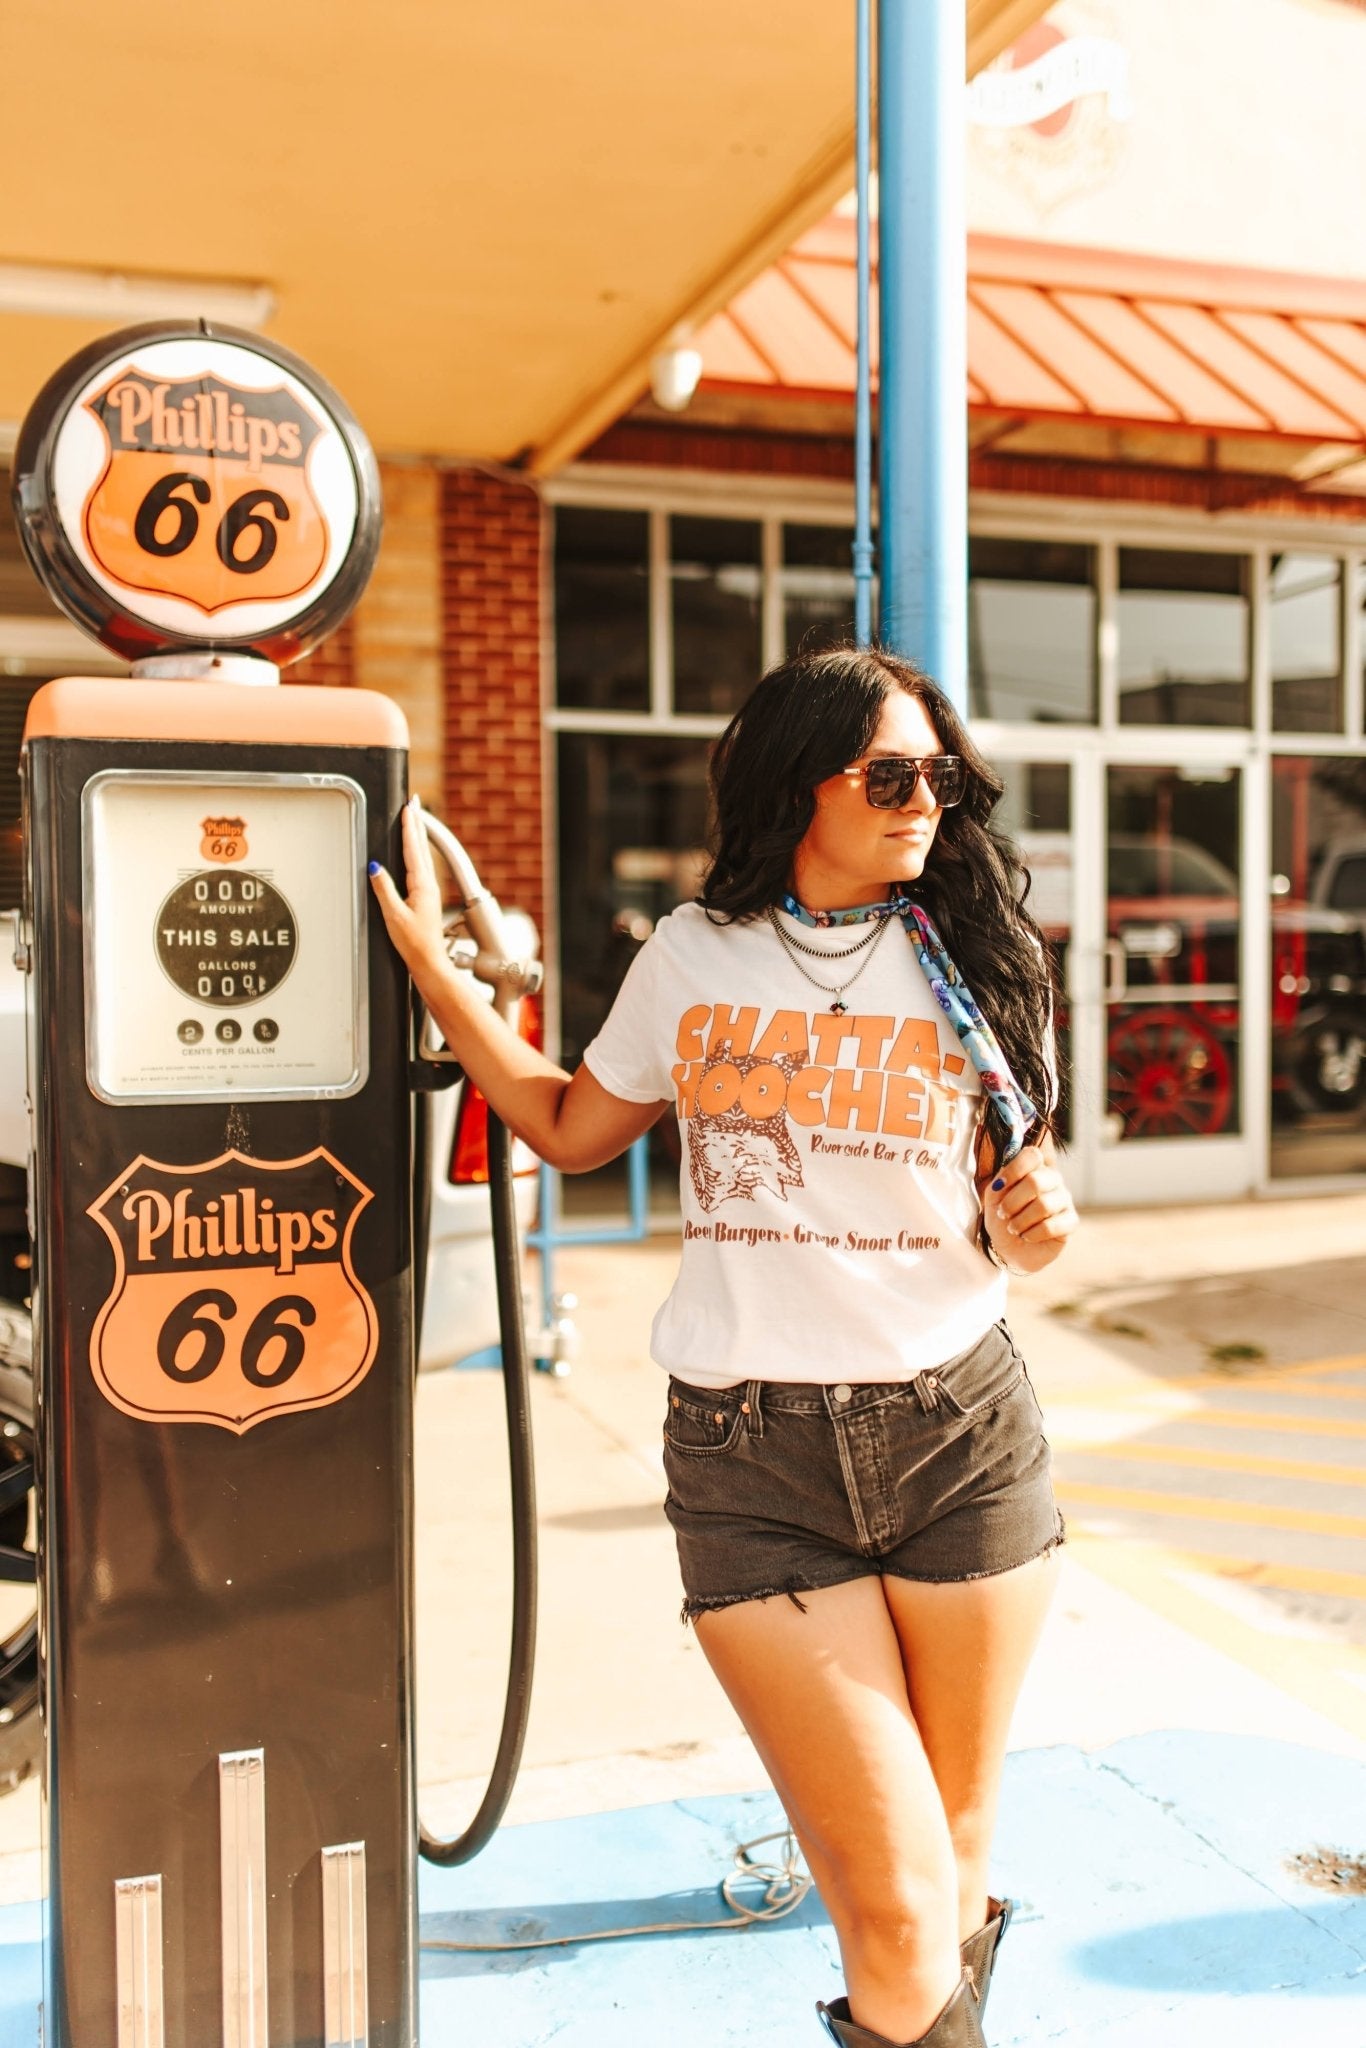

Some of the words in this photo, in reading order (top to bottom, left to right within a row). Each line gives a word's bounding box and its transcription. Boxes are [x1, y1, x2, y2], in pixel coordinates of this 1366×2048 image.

[107, 380, 303, 472] Phillips
[134, 472, 290, 575] 66
[204, 822, 242, 837] Phillips
[211, 839, 238, 857] 66
[199, 904, 254, 914] AMOUNT
[163, 929, 217, 946] THIS
[230, 929, 290, 946] SALE
[198, 961, 257, 971] GALLONS
[222, 1025, 234, 1039] 6
[182, 1047, 213, 1057] CENTS
[216, 1047, 234, 1056] PER
[238, 1046, 276, 1056] GALLON
[810, 1133, 869, 1158] Riverside
[874, 1142, 898, 1162] Bar
[122, 1188, 338, 1273] Phillips
[715, 1222, 781, 1247] Burgers
[844, 1230, 892, 1251] Snow
[898, 1229, 941, 1251] Cones
[157, 1288, 317, 1388] 66
